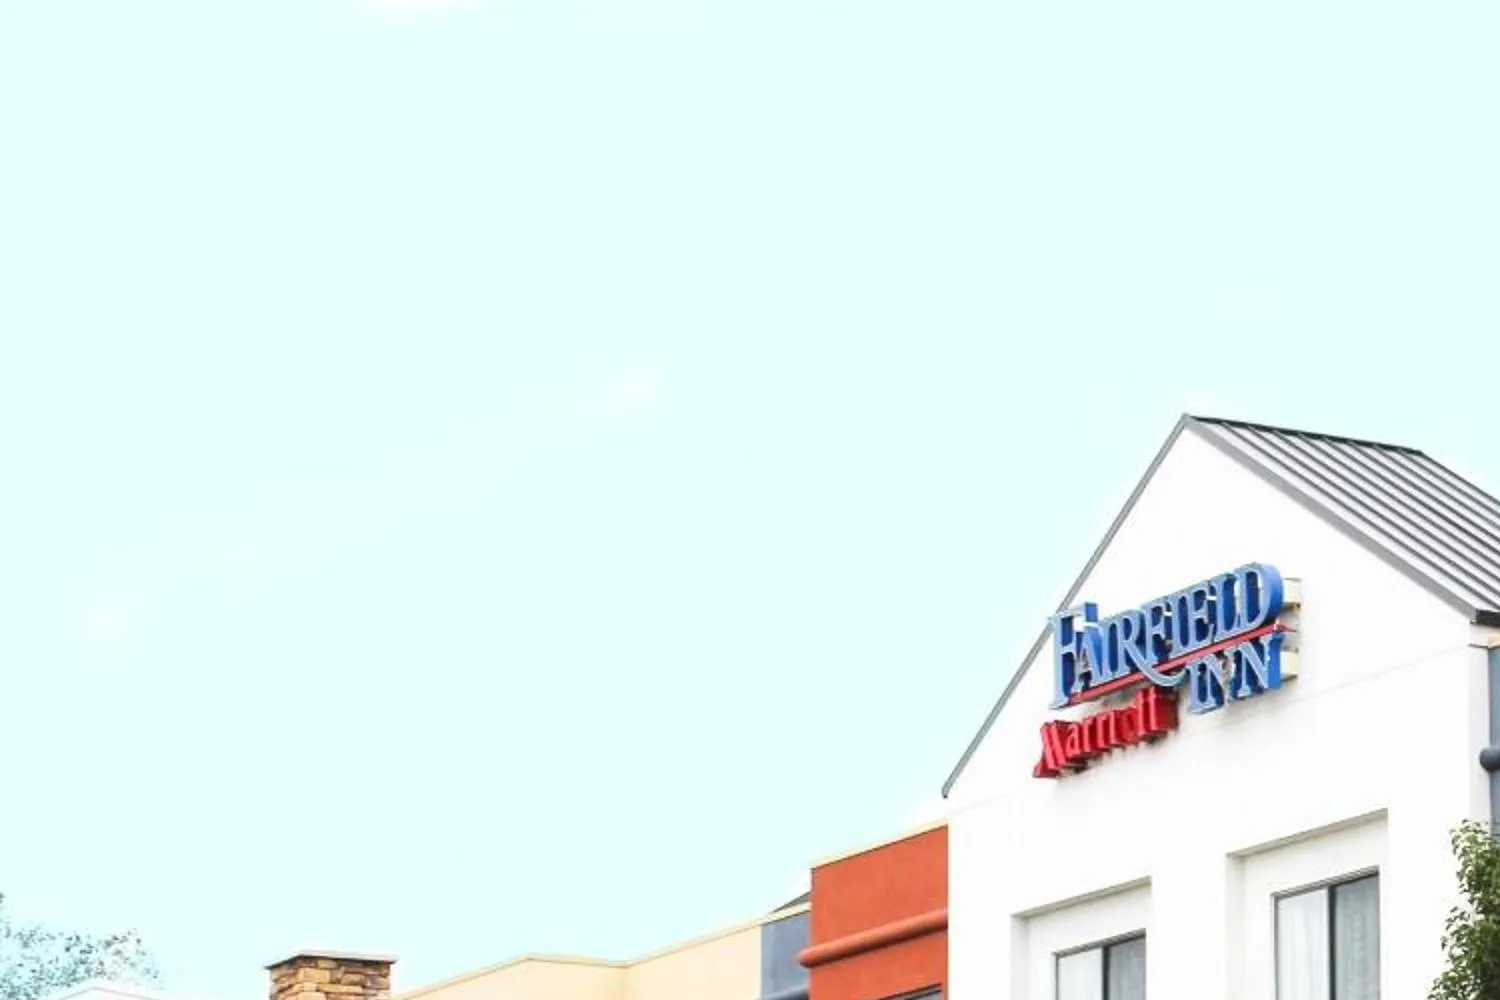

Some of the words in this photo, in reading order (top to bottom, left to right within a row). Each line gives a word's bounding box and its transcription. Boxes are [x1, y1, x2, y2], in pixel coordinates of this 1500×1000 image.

[1047, 562, 1284, 710] FAIRFIELD
[1187, 632, 1283, 714] INN
[1032, 687, 1178, 778] Marriott
